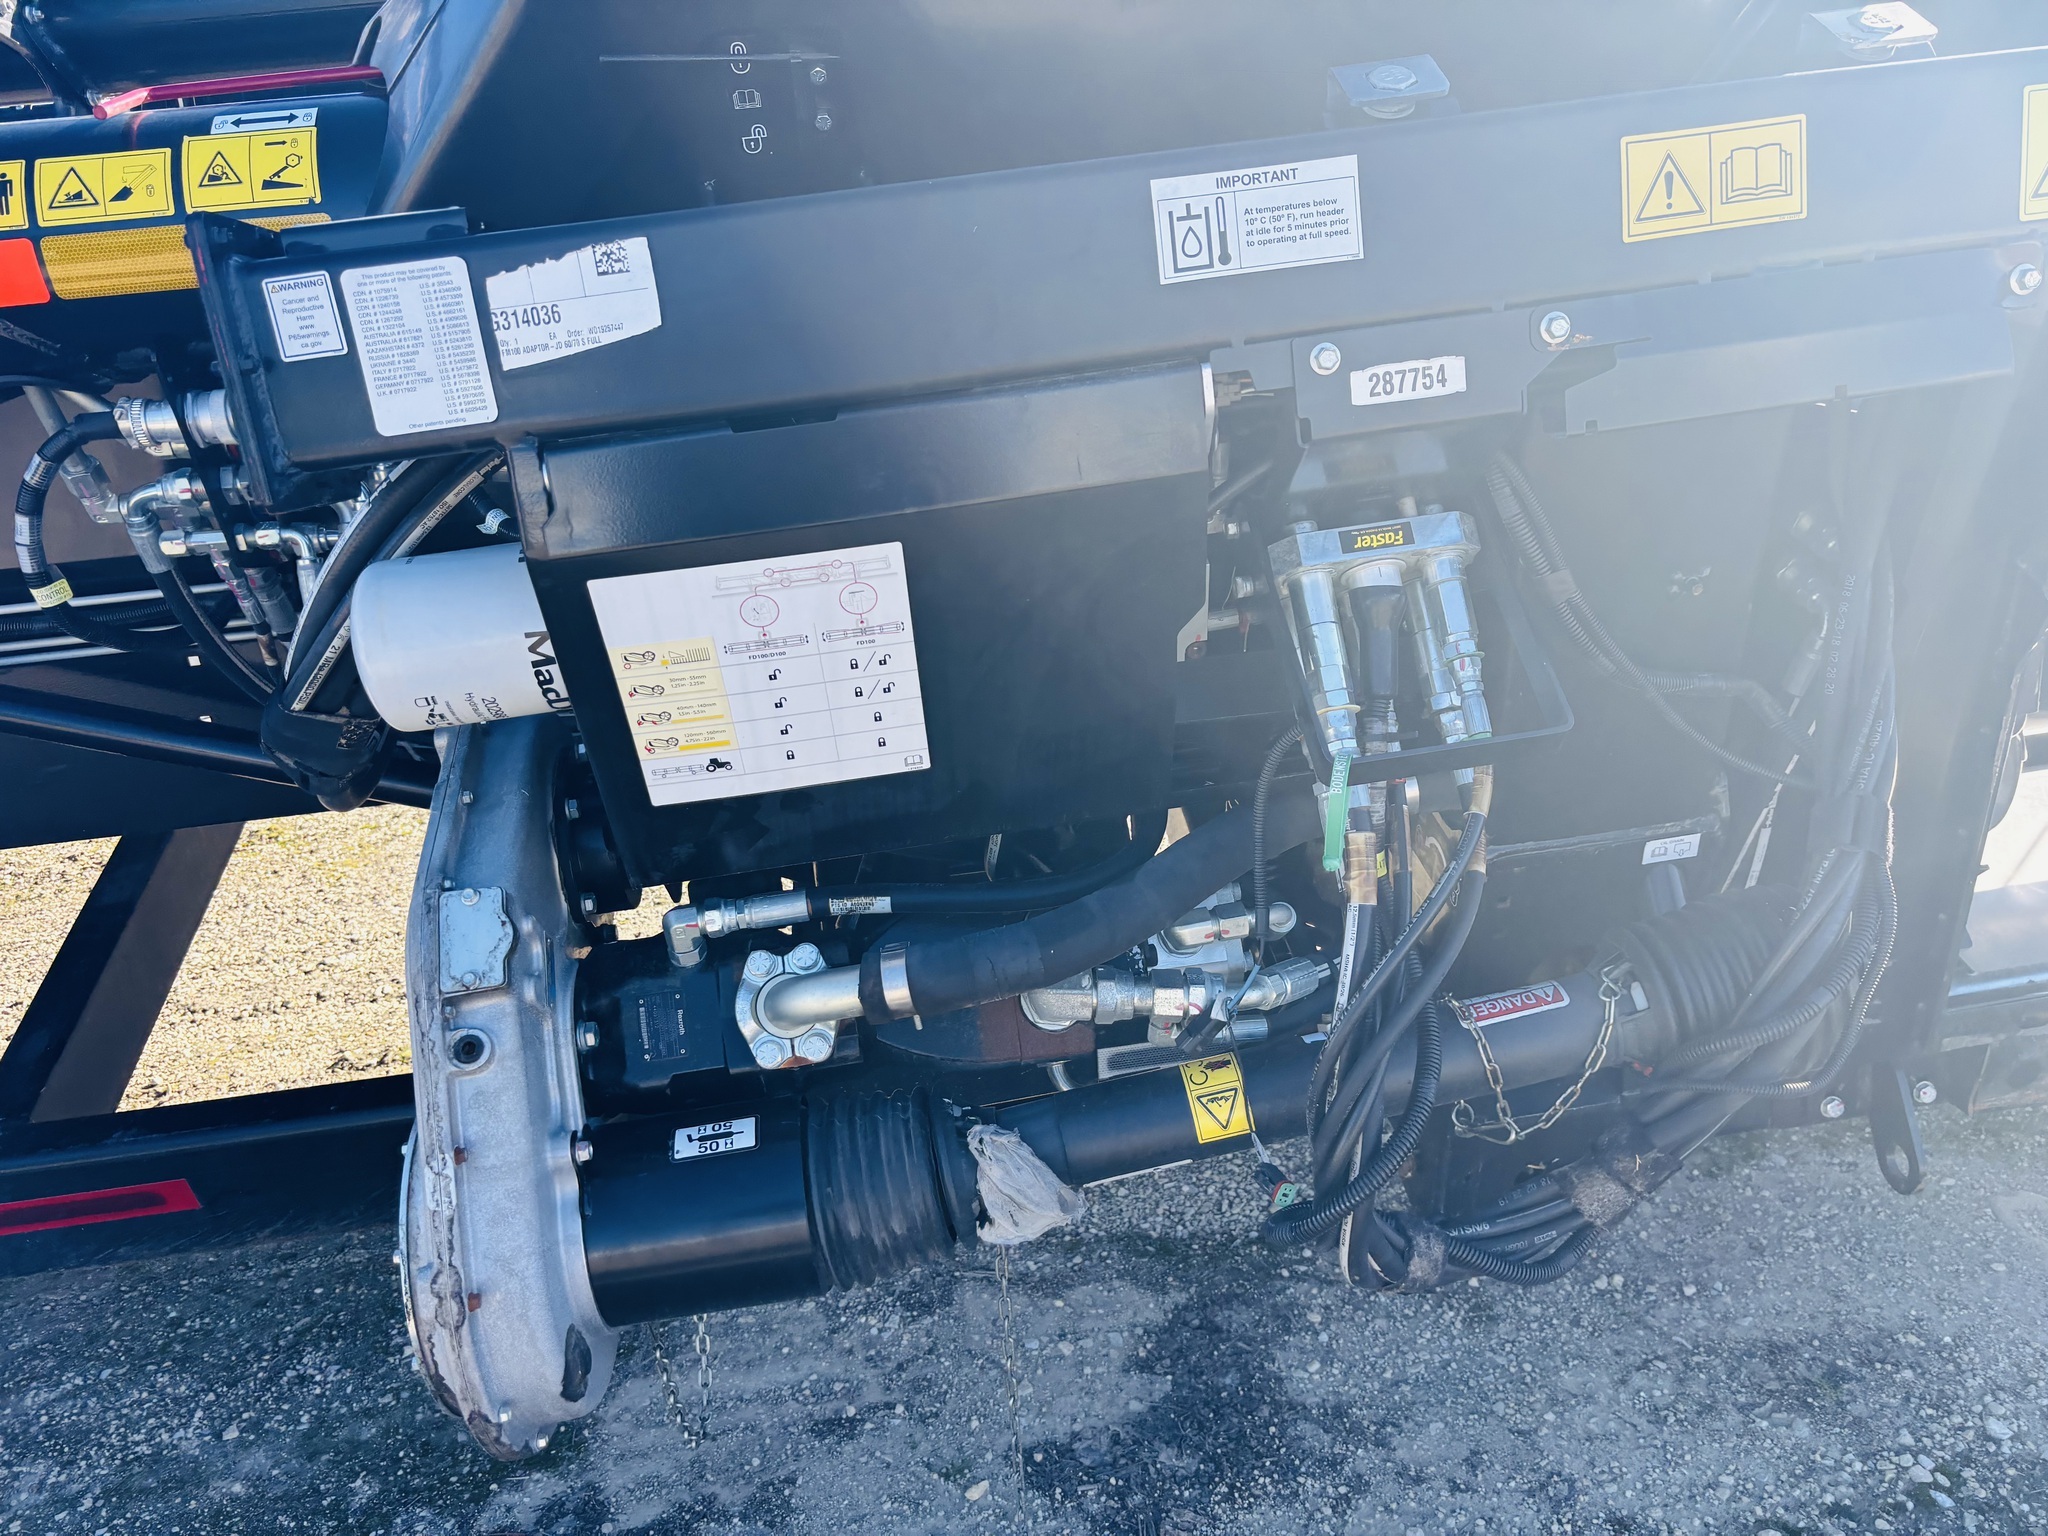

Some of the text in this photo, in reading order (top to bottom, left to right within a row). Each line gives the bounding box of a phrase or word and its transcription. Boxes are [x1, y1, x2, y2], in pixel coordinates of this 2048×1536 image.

[1215, 168, 1298, 189] IMPORTANT
[1256, 202, 1311, 216] temperatures
[1313, 198, 1338, 207] below
[1316, 208, 1344, 217] header
[1256, 226, 1271, 236] idle
[1295, 220, 1328, 230] minutes
[1330, 217, 1349, 227] prior
[1257, 235, 1297, 248] operating
[1309, 231, 1323, 240] full
[1324, 228, 1351, 238] speed.
[278, 279, 324, 291] WARNING
[282, 304, 324, 314] Reproductive
[364, 332, 396, 340] AUSTRALIA
[549, 332, 557, 340] EA
[365, 339, 397, 347] AUSTRALIA
[522, 344, 549, 355] ADAPTOR
[555, 342, 562, 350] JD
[587, 336, 601, 345] FULL
[367, 345, 405, 354] KAZAKHSTAN
[1368, 364, 1447, 398] 287754
[425, 420, 444, 428] patents
[446, 417, 466, 425] pending
[1354, 531, 1403, 548] Faster
[37, 586, 68, 601] CONTROL
[329, 645, 340, 654] 21
[712, 1122, 733, 1132] 50
[698, 1141, 719, 1153] 50
